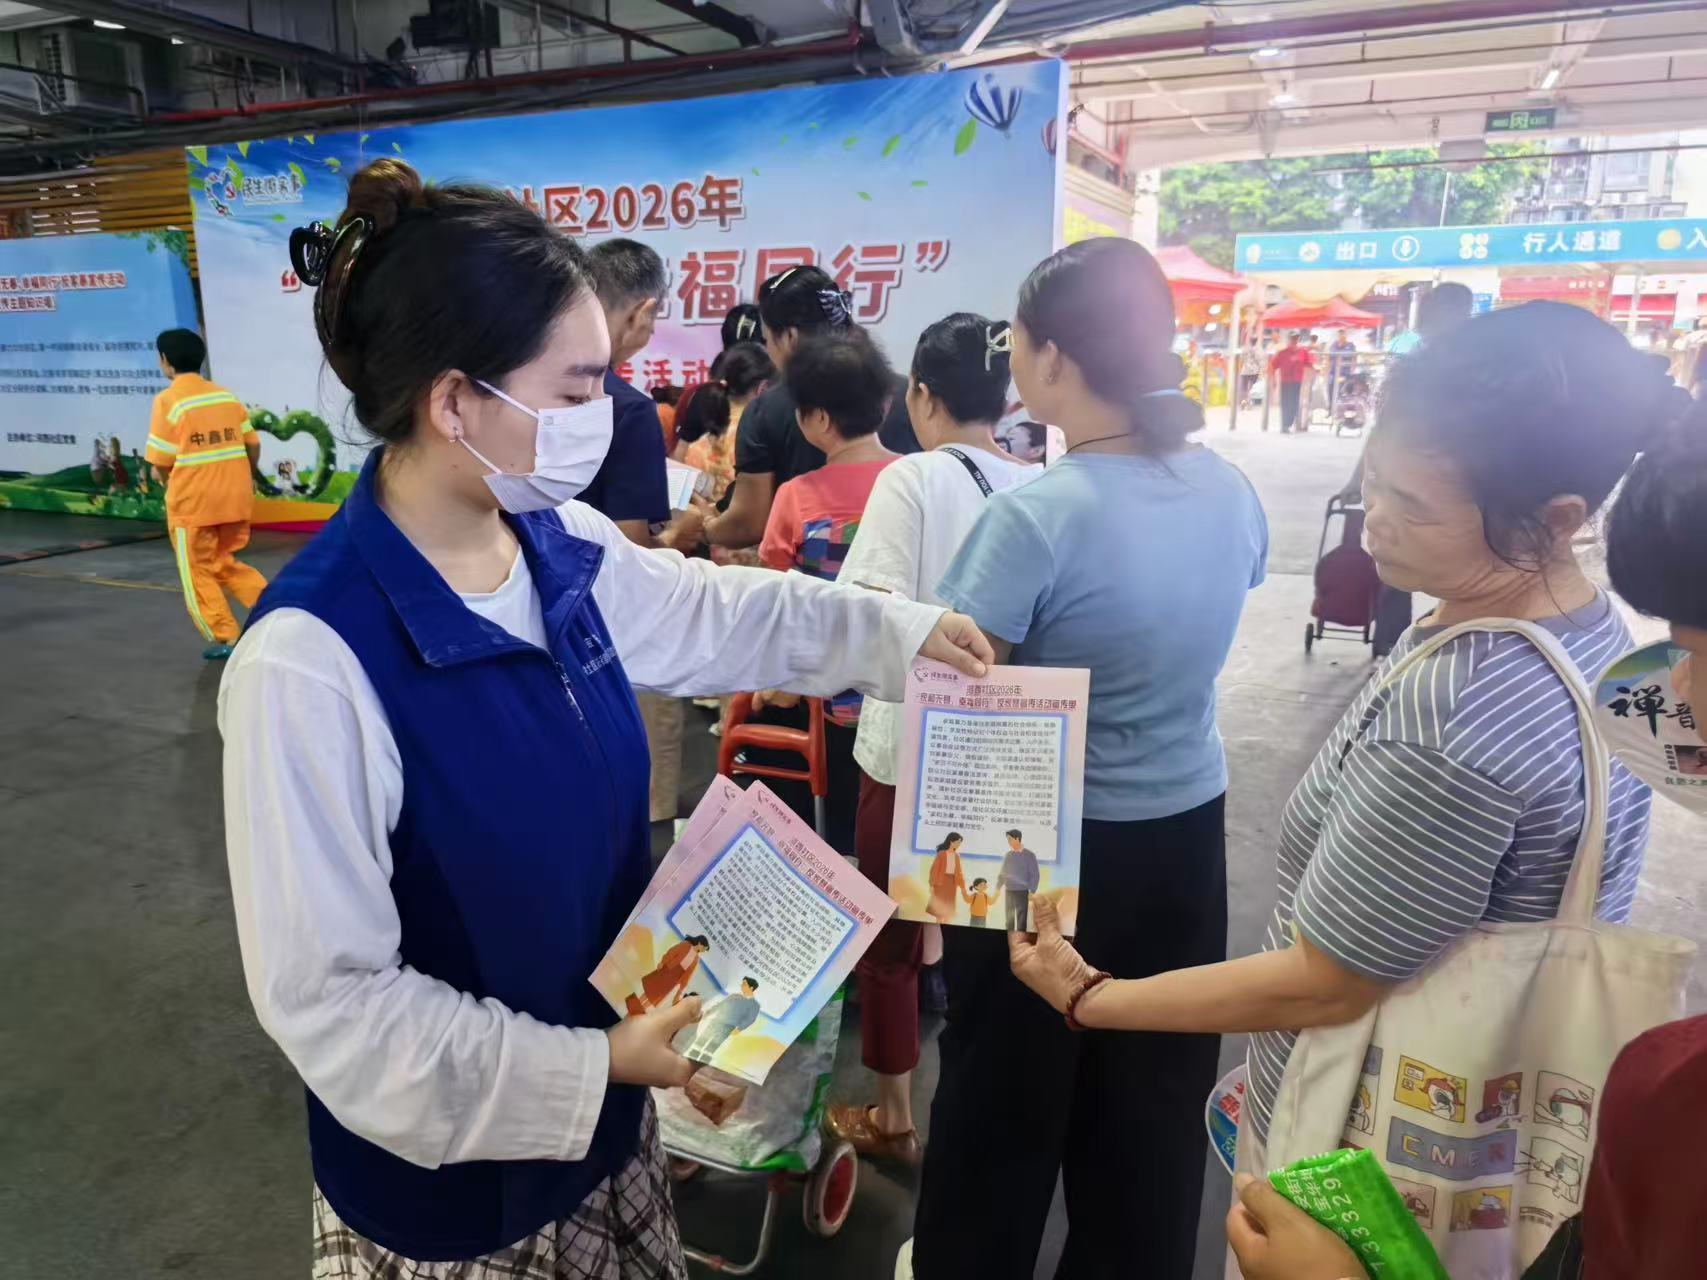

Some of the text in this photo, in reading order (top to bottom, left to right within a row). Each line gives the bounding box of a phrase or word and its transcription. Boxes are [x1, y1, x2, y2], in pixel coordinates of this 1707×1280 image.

[1335, 241, 1377, 261] 出口
[1523, 229, 1622, 253] 行人通道
